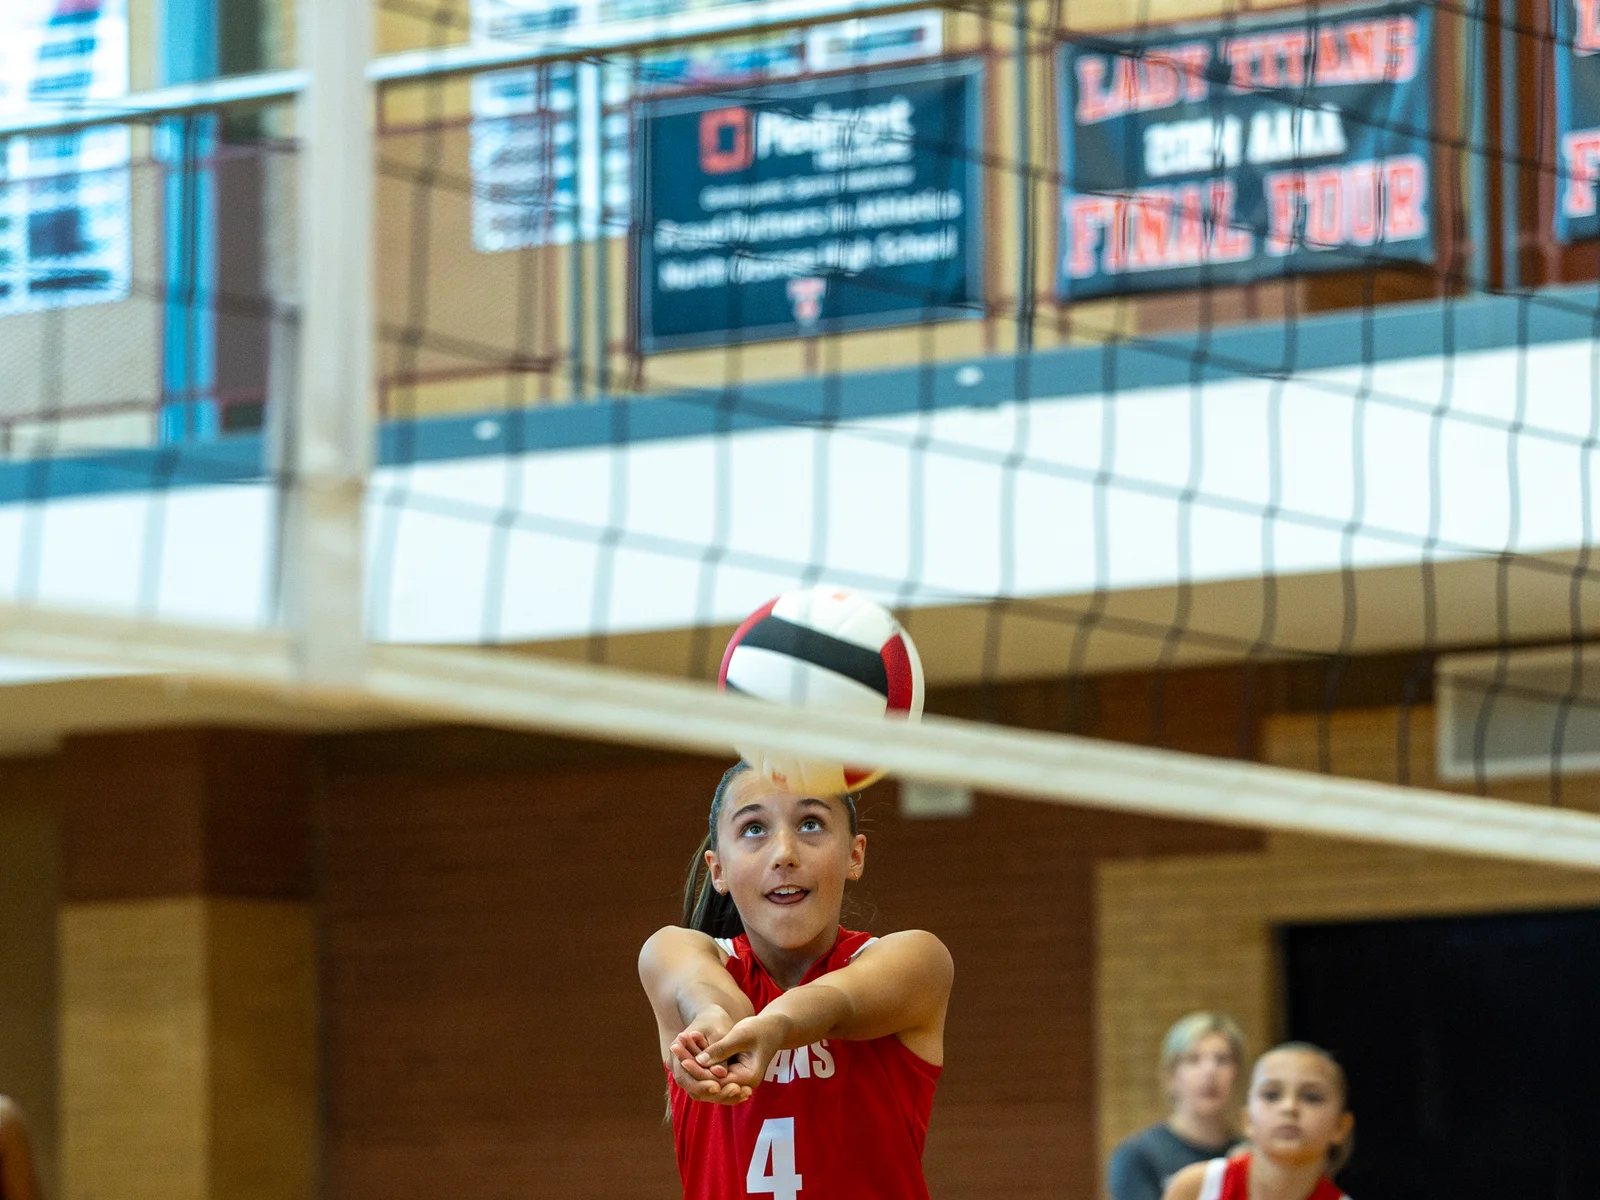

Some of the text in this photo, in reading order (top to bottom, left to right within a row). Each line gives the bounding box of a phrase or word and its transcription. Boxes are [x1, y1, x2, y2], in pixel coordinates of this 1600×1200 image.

[1077, 16, 1417, 125] LADY TITANS
[1065, 154, 1428, 280] FINAL FOUR
[764, 1039, 836, 1084] ANS
